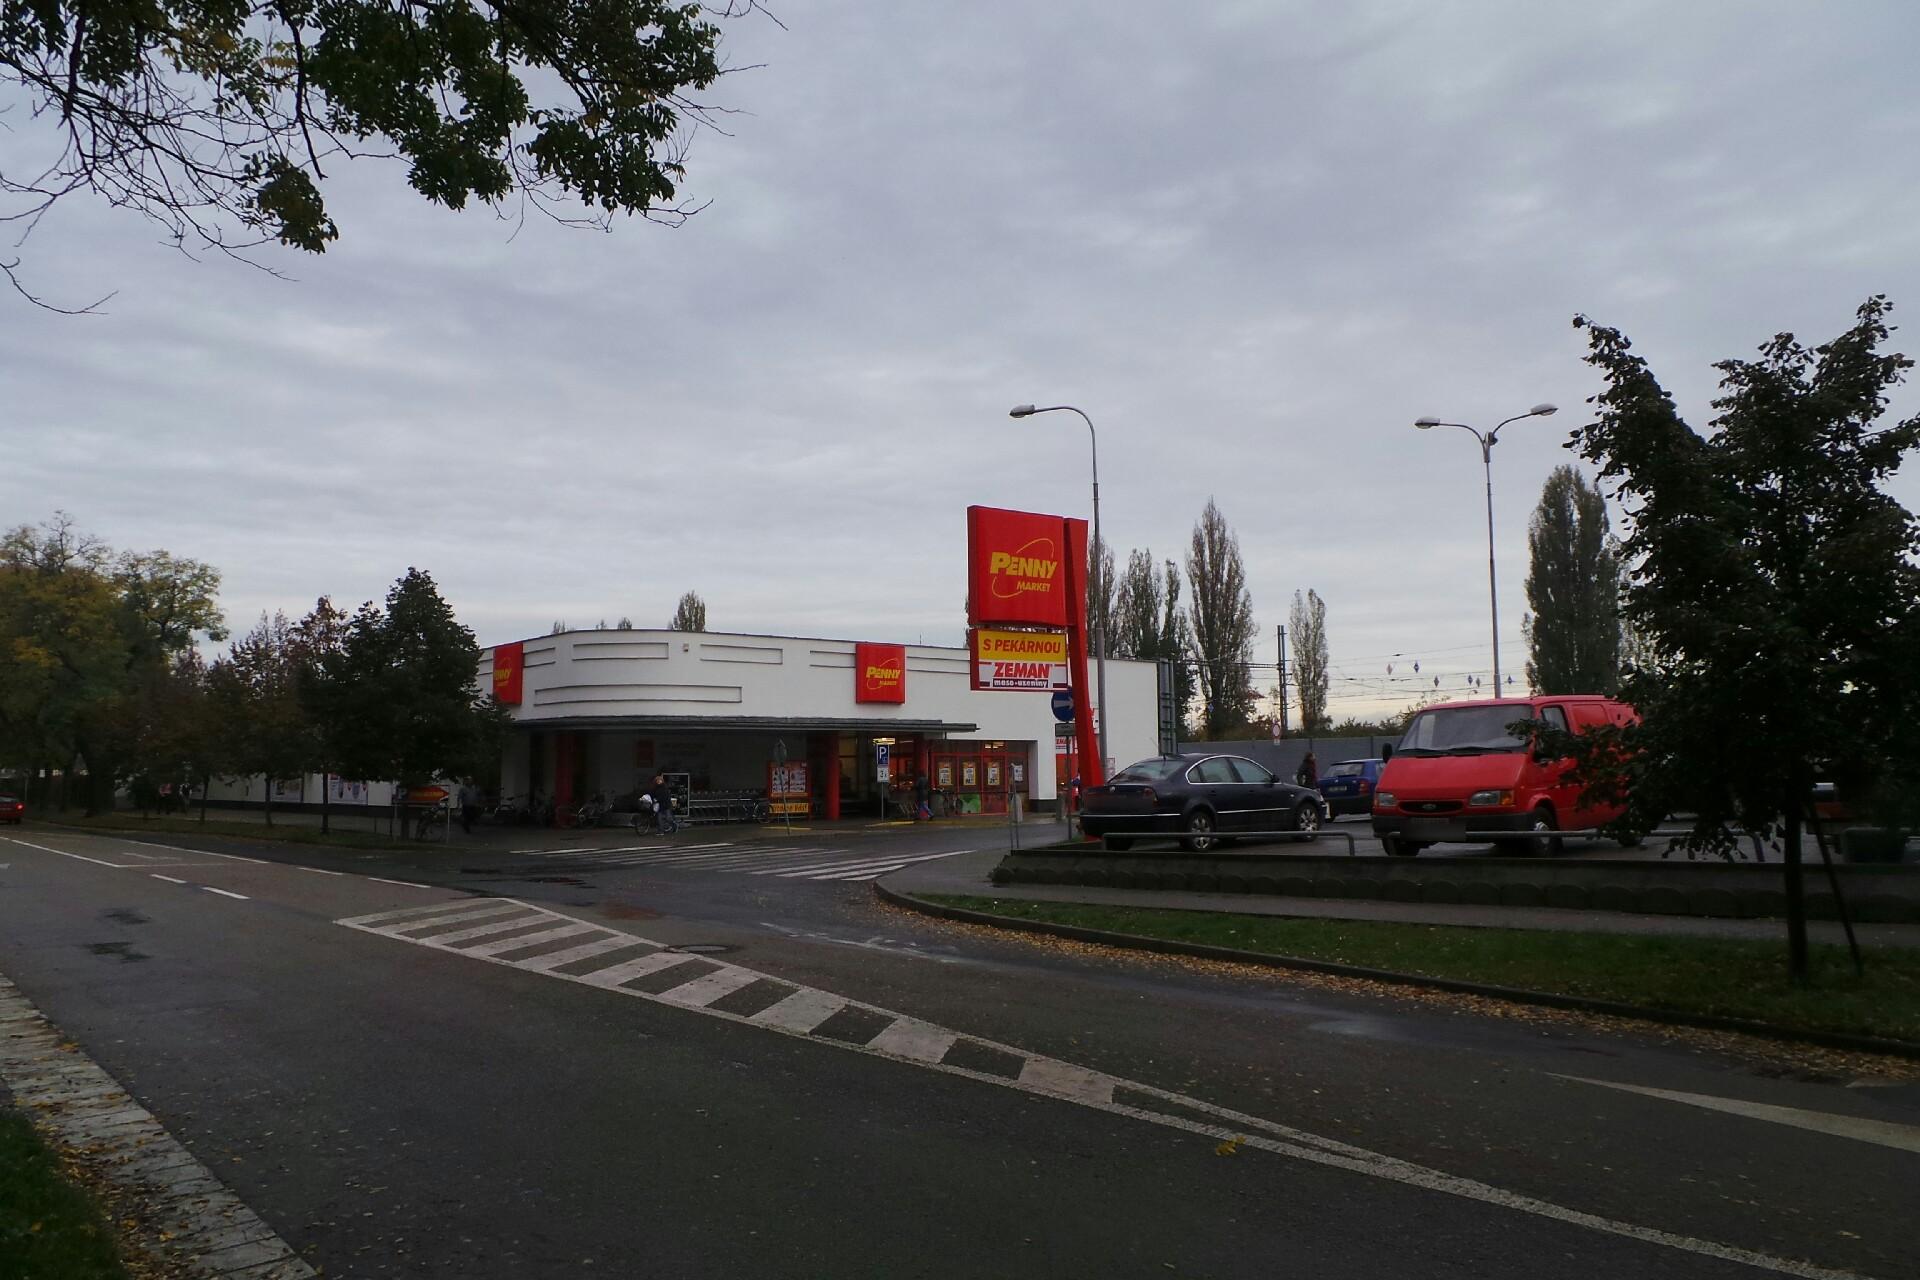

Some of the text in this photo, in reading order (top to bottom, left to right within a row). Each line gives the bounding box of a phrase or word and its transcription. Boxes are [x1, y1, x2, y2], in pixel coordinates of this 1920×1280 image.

[989, 551, 1057, 579] PENNY
[1016, 581, 1051, 592] MARKET
[983, 637, 1061, 654] S PEKÁRNOU
[866, 666, 901, 679] PENNY
[993, 662, 1050, 678] ZEMAN
[879, 746, 887, 759] P
